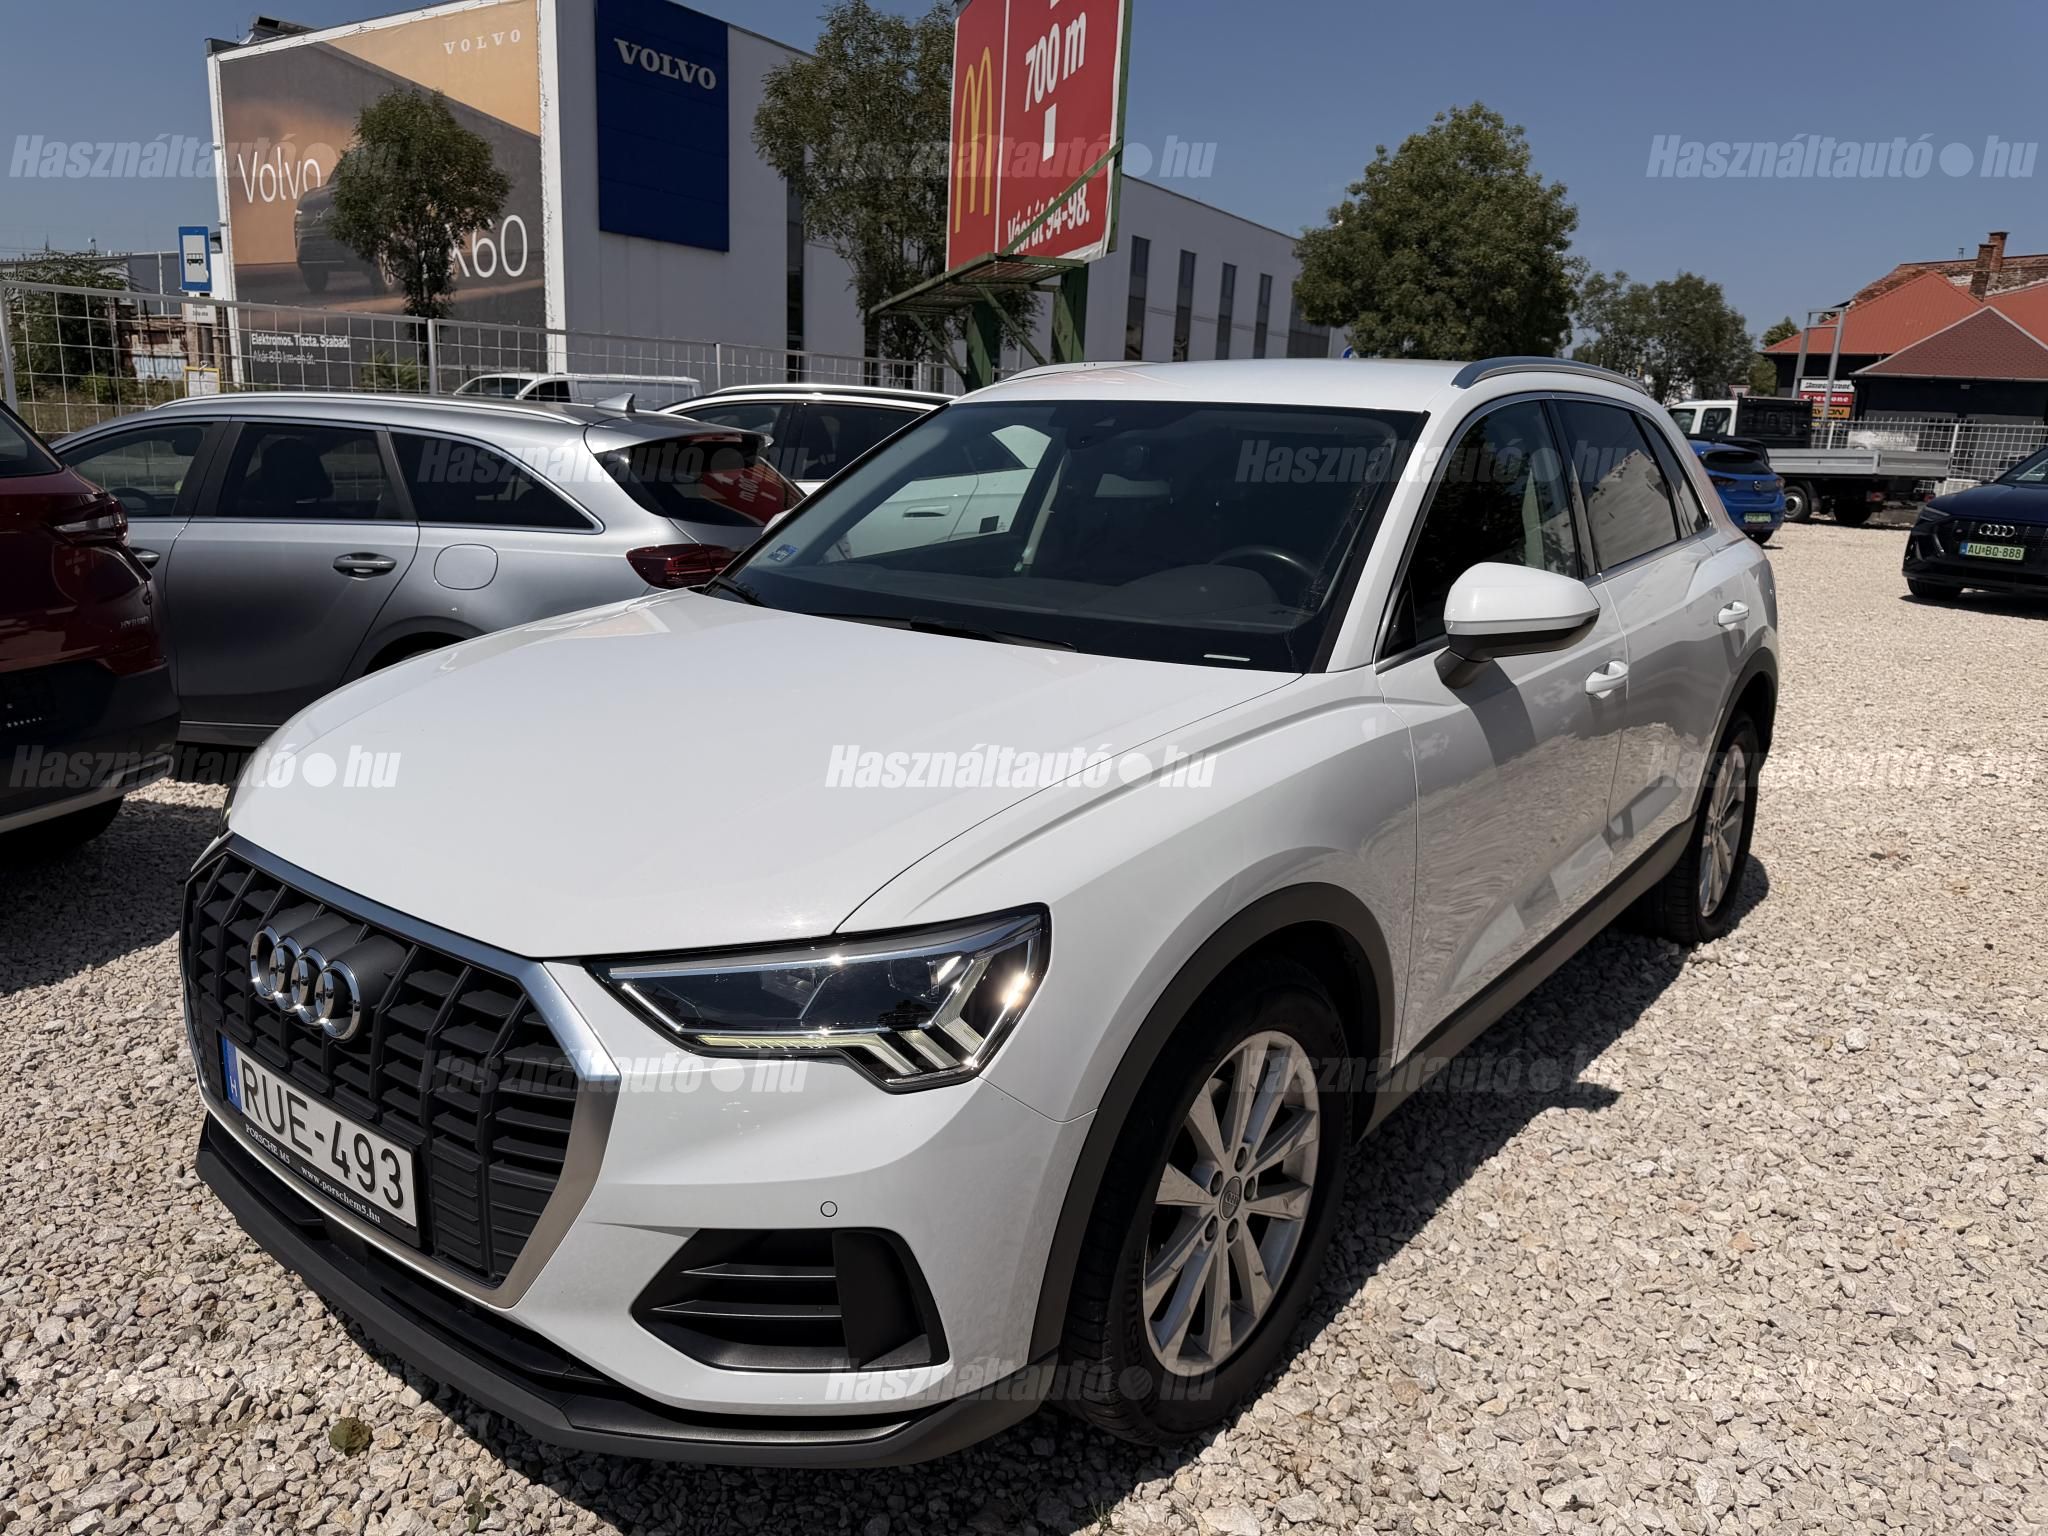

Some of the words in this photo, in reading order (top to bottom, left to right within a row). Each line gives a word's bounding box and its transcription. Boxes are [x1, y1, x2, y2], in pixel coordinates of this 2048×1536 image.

[443, 29, 521, 55] VOLVO
[613, 37, 717, 91] VOLVO
[1024, 22, 1060, 113] 700
[1062, 11, 1087, 81] m
[237, 146, 322, 204] Volvo
[251, 332, 294, 346] Elektromos.
[240, 1057, 405, 1210] RUE-493
[245, 1123, 278, 1155] PORSCHE
[300, 1165, 381, 1224] www.porschem5.hu
